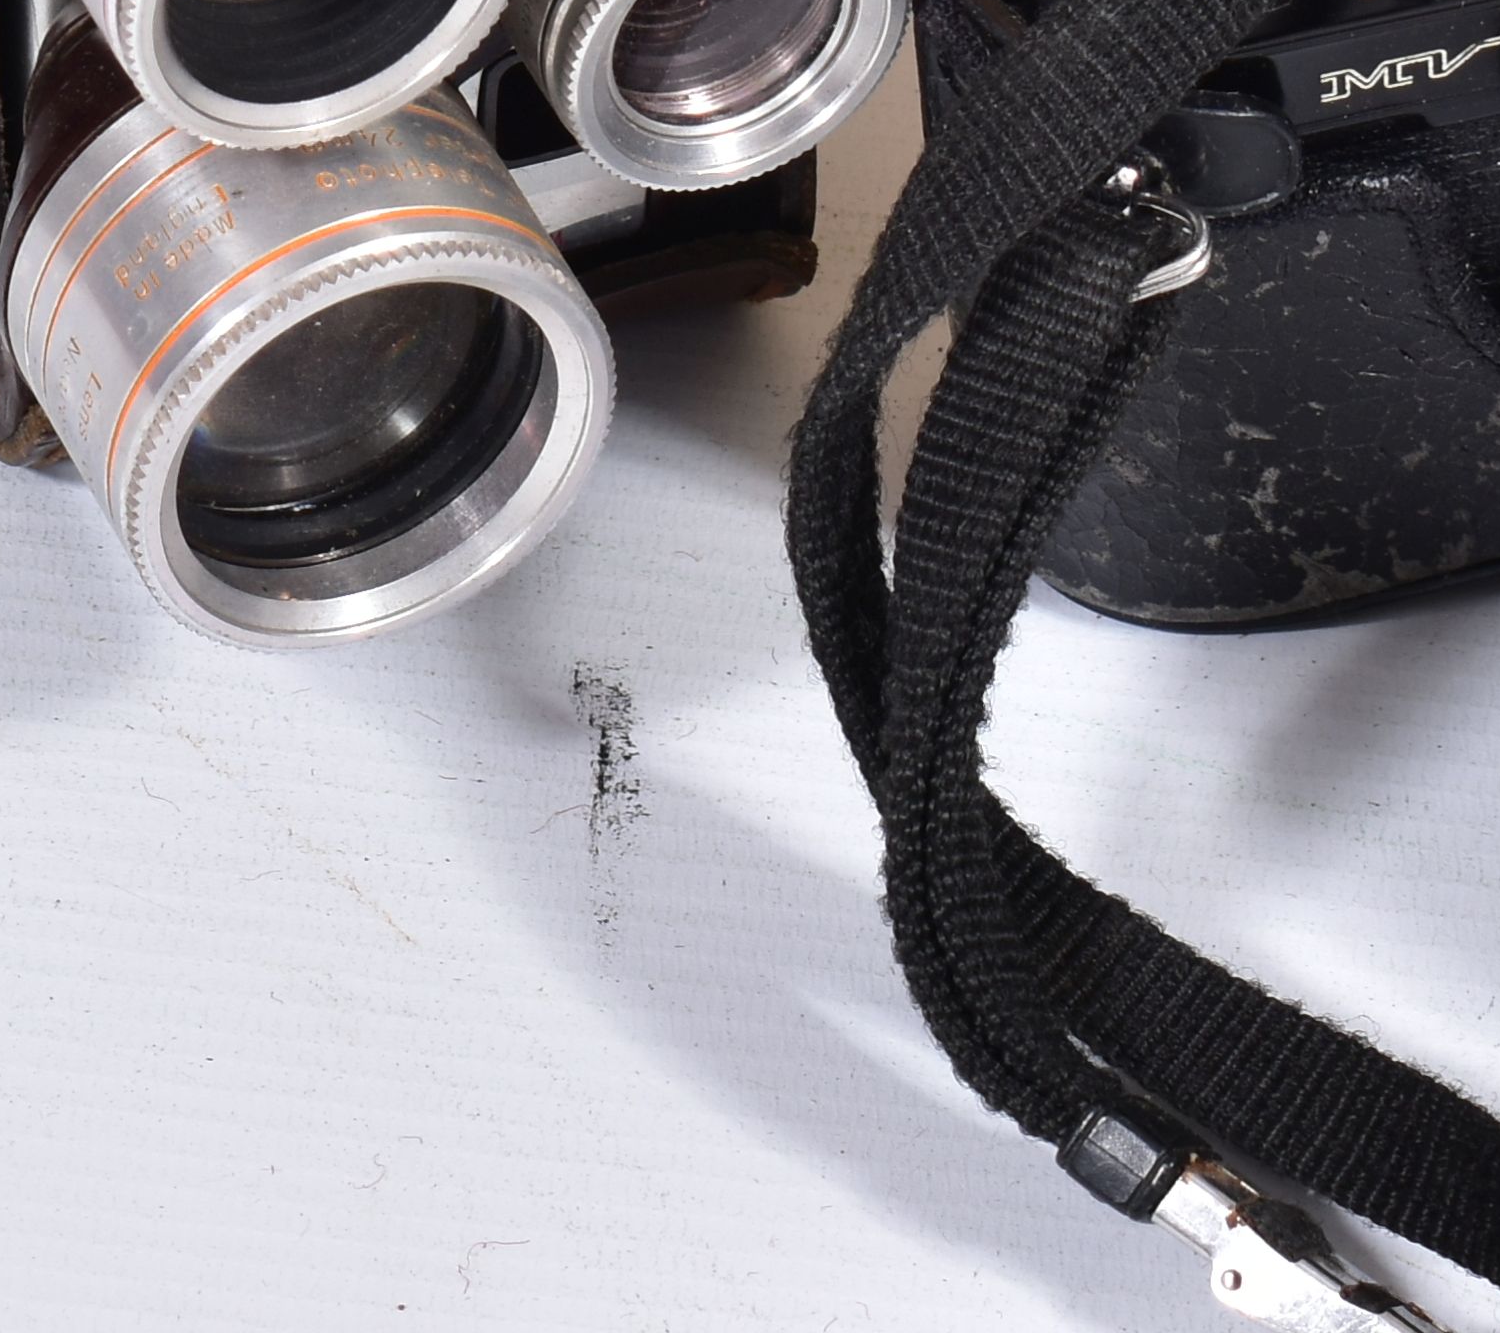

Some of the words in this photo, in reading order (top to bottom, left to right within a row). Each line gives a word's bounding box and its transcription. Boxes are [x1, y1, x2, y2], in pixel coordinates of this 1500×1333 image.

[114, 183, 230, 288] England
[164, 208, 235, 272] Made
[79, 371, 103, 442] Lens
